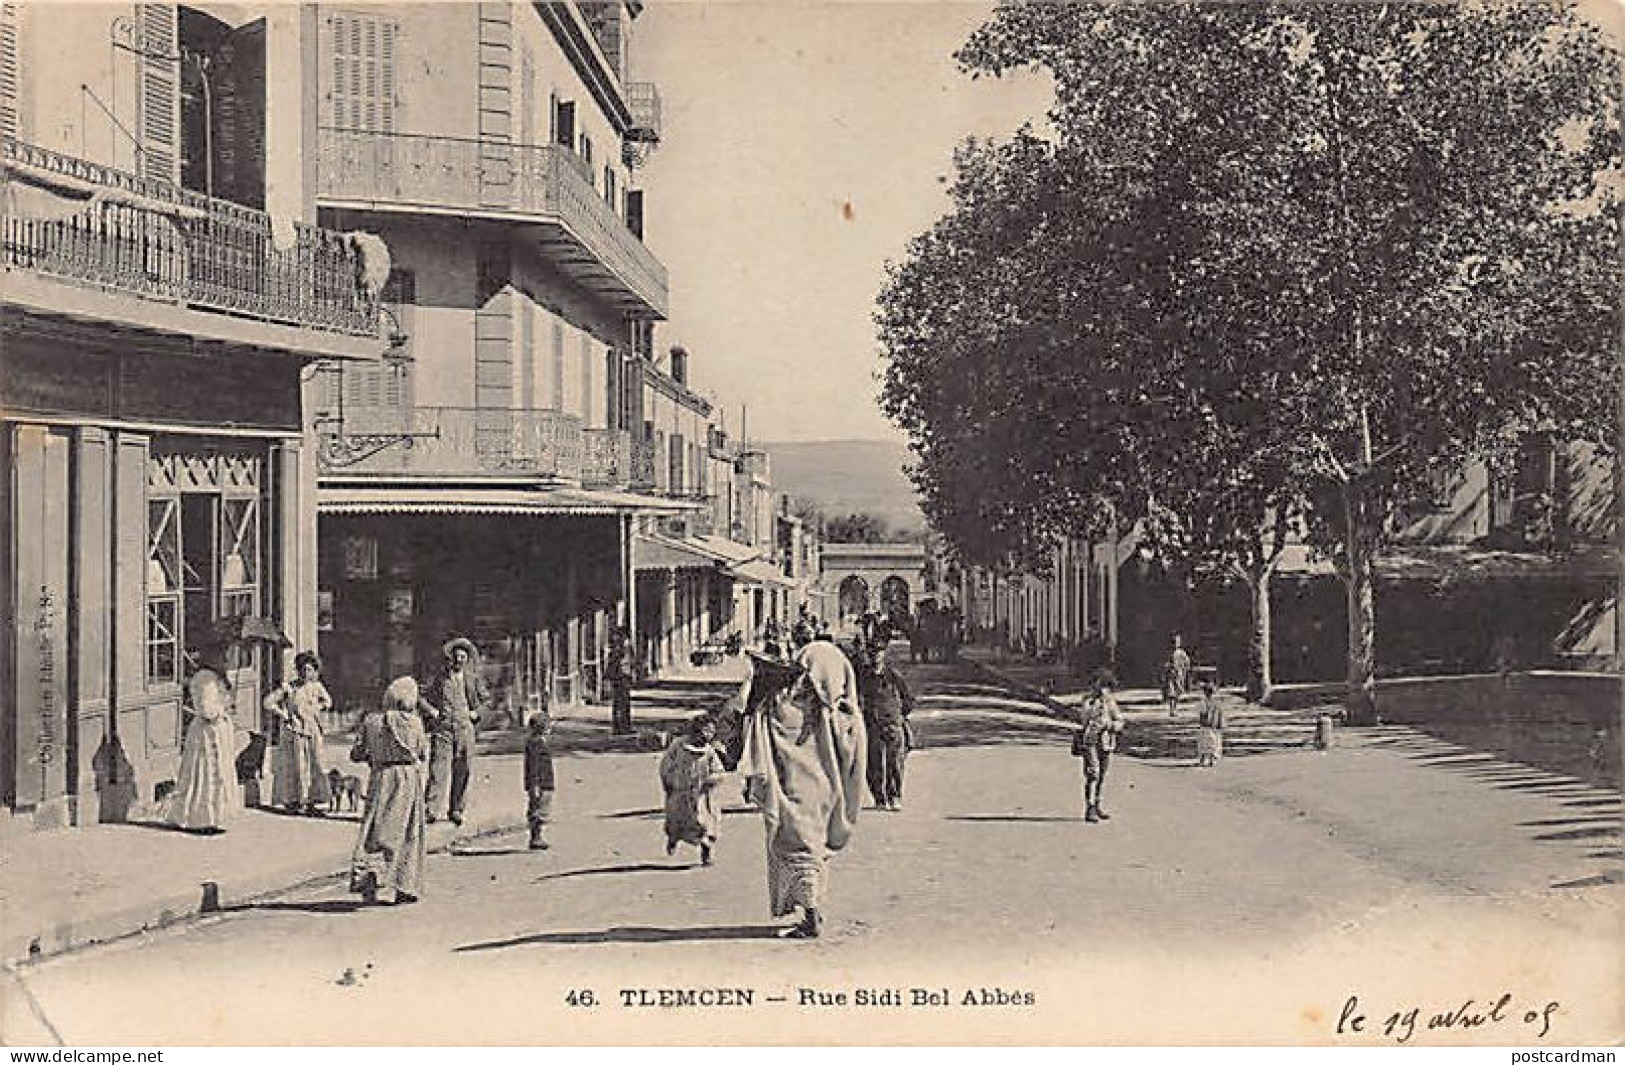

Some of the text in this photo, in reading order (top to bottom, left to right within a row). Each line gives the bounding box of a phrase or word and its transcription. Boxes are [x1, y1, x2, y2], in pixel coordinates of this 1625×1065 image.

[1336, 996, 1366, 1034] le
[1384, 1008, 1420, 1044] 19
[1428, 993, 1511, 1030] avril
